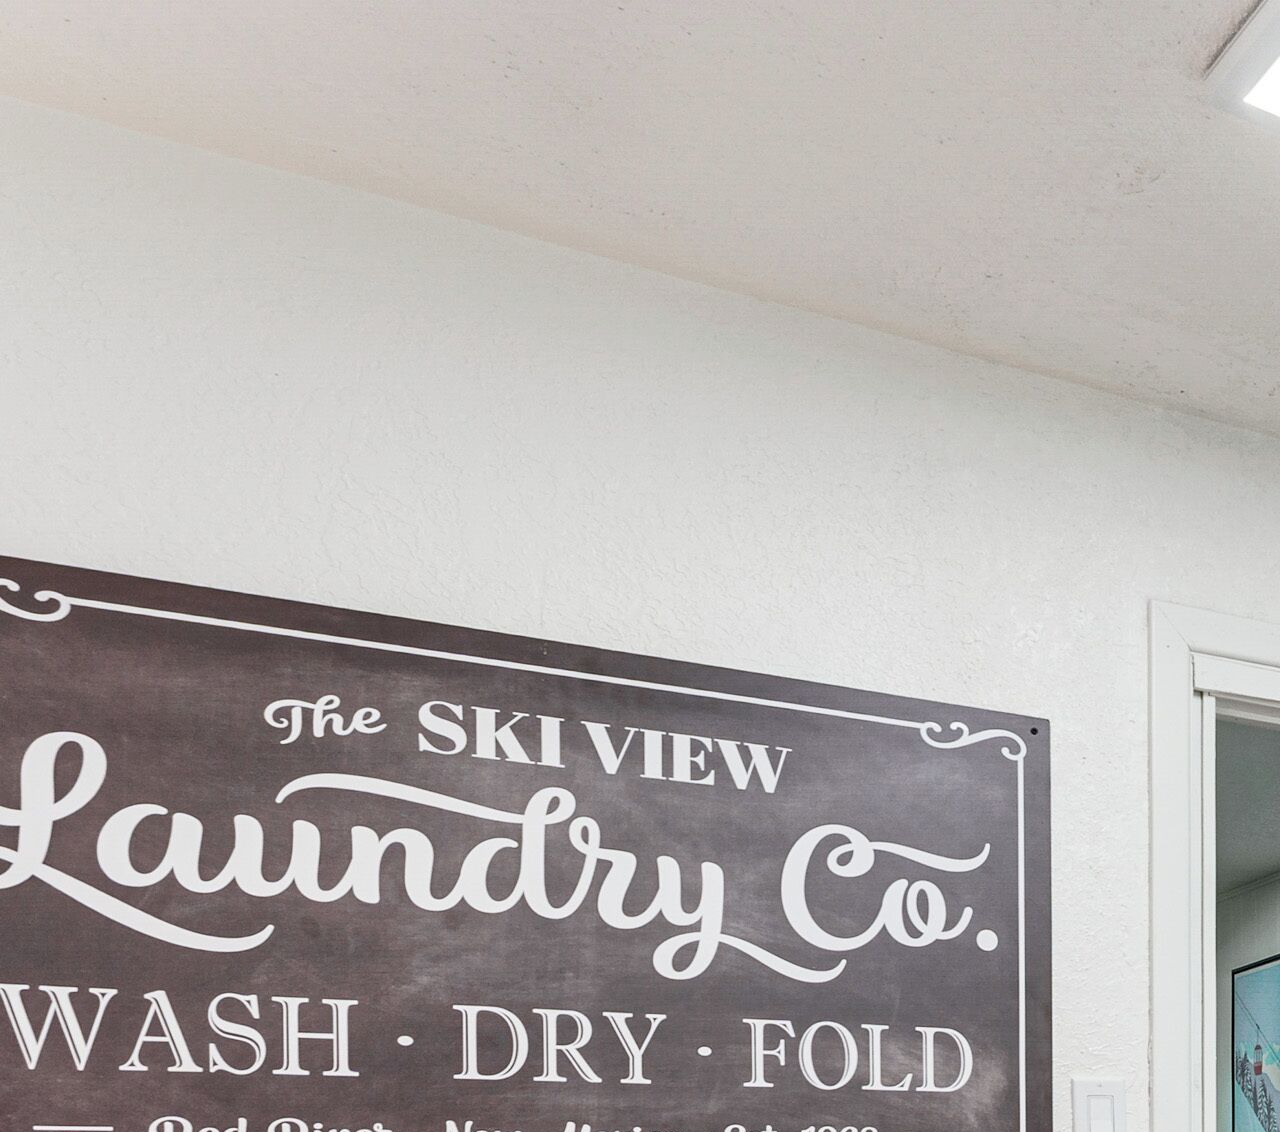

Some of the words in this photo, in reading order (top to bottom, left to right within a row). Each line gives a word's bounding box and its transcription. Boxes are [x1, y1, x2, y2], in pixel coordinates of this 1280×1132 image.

[263, 692, 388, 745] The
[416, 698, 567, 770] SKI
[581, 719, 794, 797] VIEW
[0, 729, 847, 984] Laundry
[779, 823, 1001, 954] Co.
[0, 981, 360, 1080] WASH
[452, 1003, 668, 1087] DRY
[741, 1016, 974, 1093] FOLD
